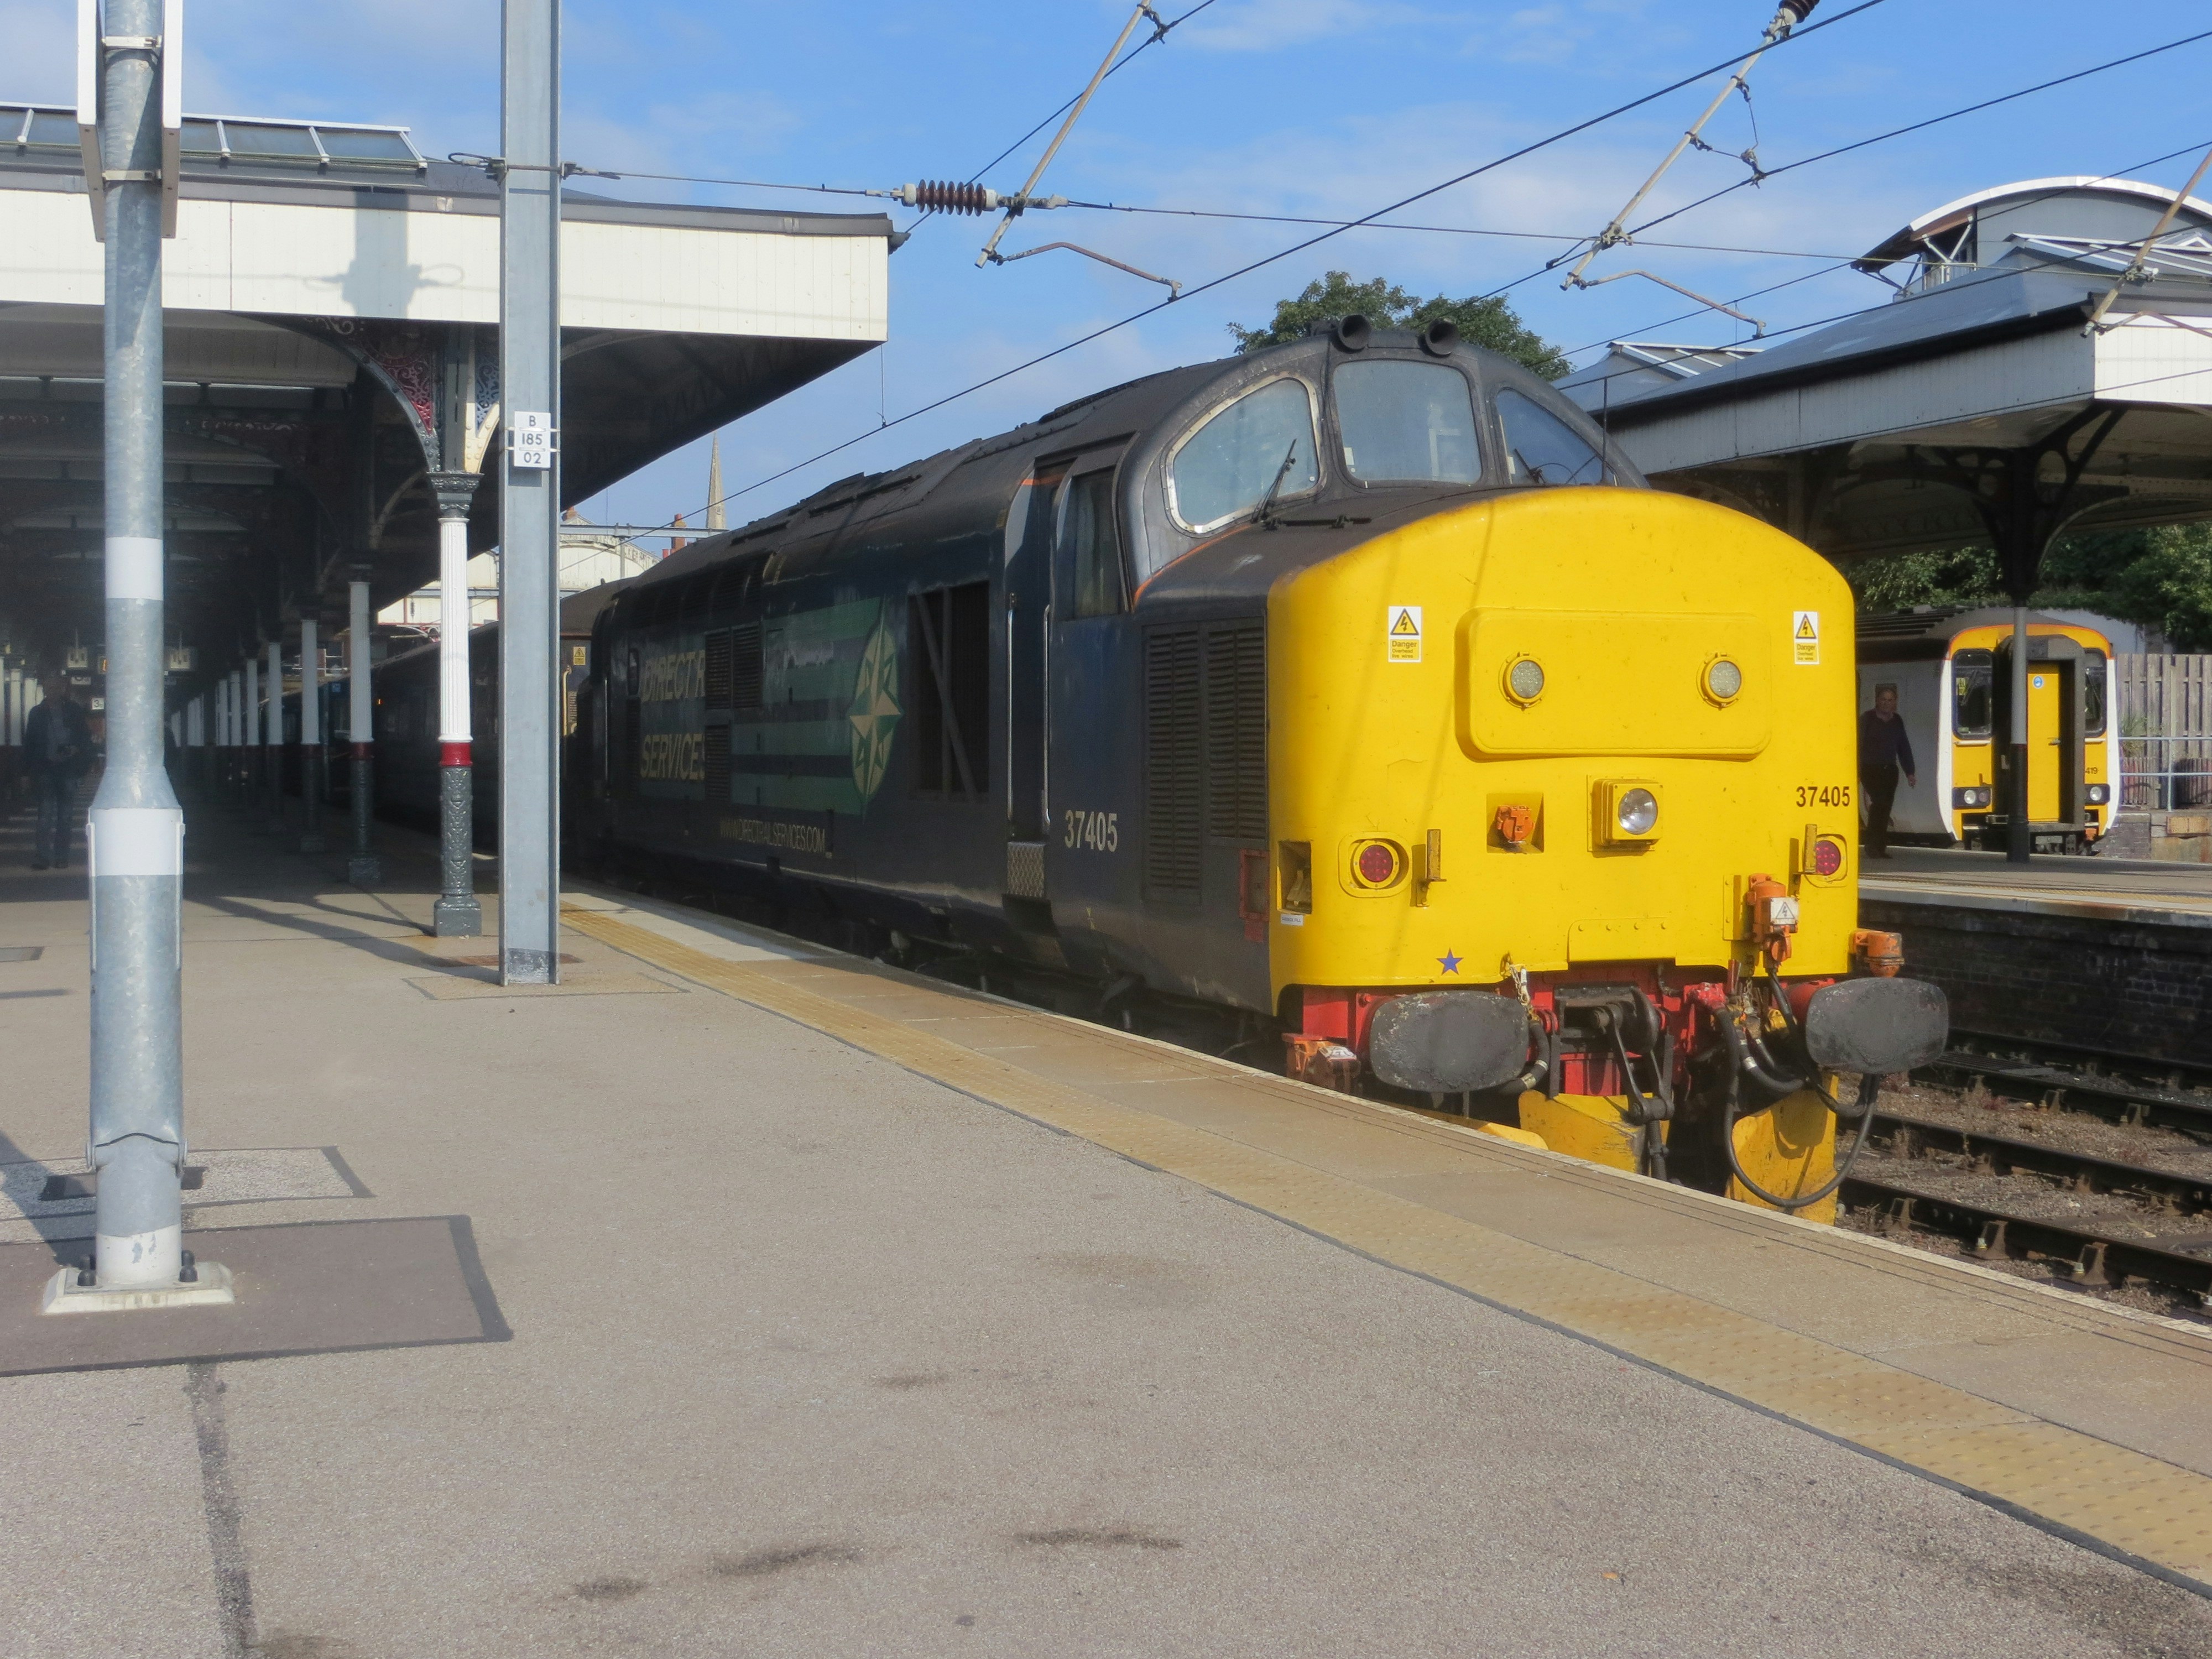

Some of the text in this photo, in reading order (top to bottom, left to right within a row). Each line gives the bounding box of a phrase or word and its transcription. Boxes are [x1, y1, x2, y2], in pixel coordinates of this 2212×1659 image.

[529, 415, 536, 426] B
[522, 434, 542, 445] 185
[524, 452, 541, 464] 02
[1392, 640, 1417, 649] Danger
[640, 651, 696, 703] DIRECT
[1796, 786, 1850, 807] 37405
[1065, 810, 1118, 852] 37405
